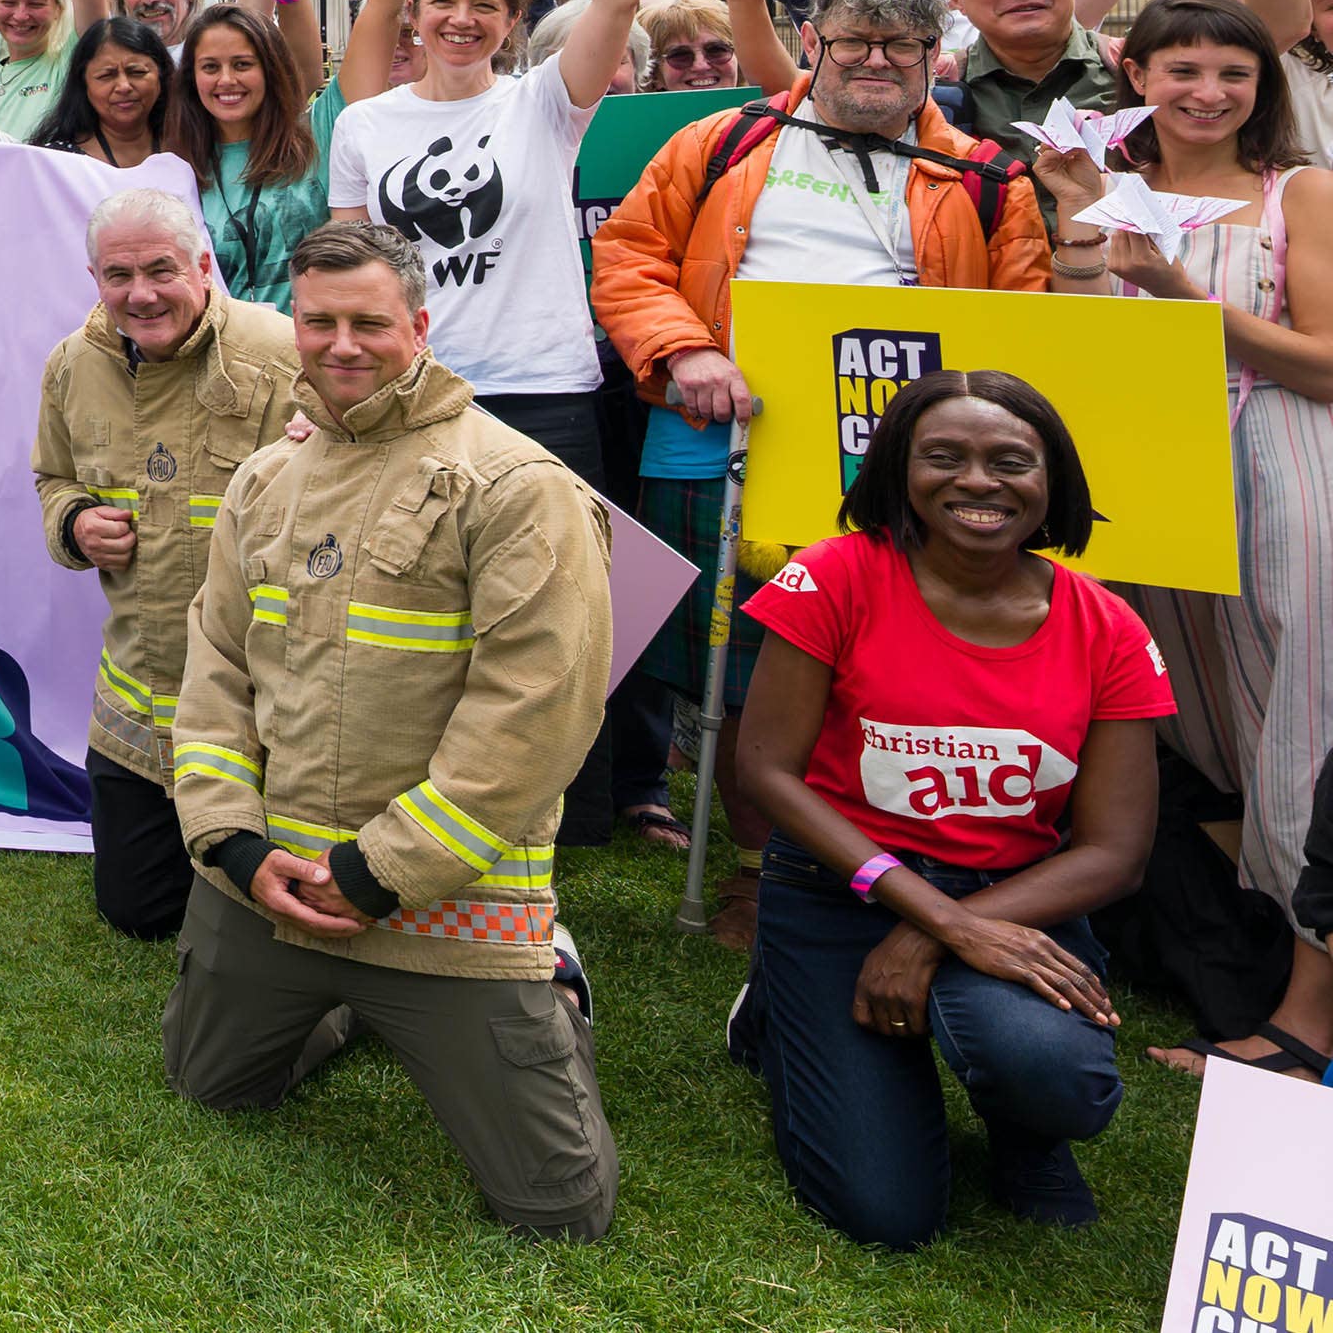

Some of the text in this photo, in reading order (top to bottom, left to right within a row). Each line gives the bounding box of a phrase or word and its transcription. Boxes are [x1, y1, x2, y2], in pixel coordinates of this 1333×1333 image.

[839, 338, 925, 379] ACT
[839, 376, 911, 416] NO
[153, 458, 169, 477] FBU
[863, 725, 1000, 761] christian
[904, 744, 1042, 816] aid
[1209, 1219, 1328, 1291] ACT
[1202, 1259, 1333, 1333] NOW
